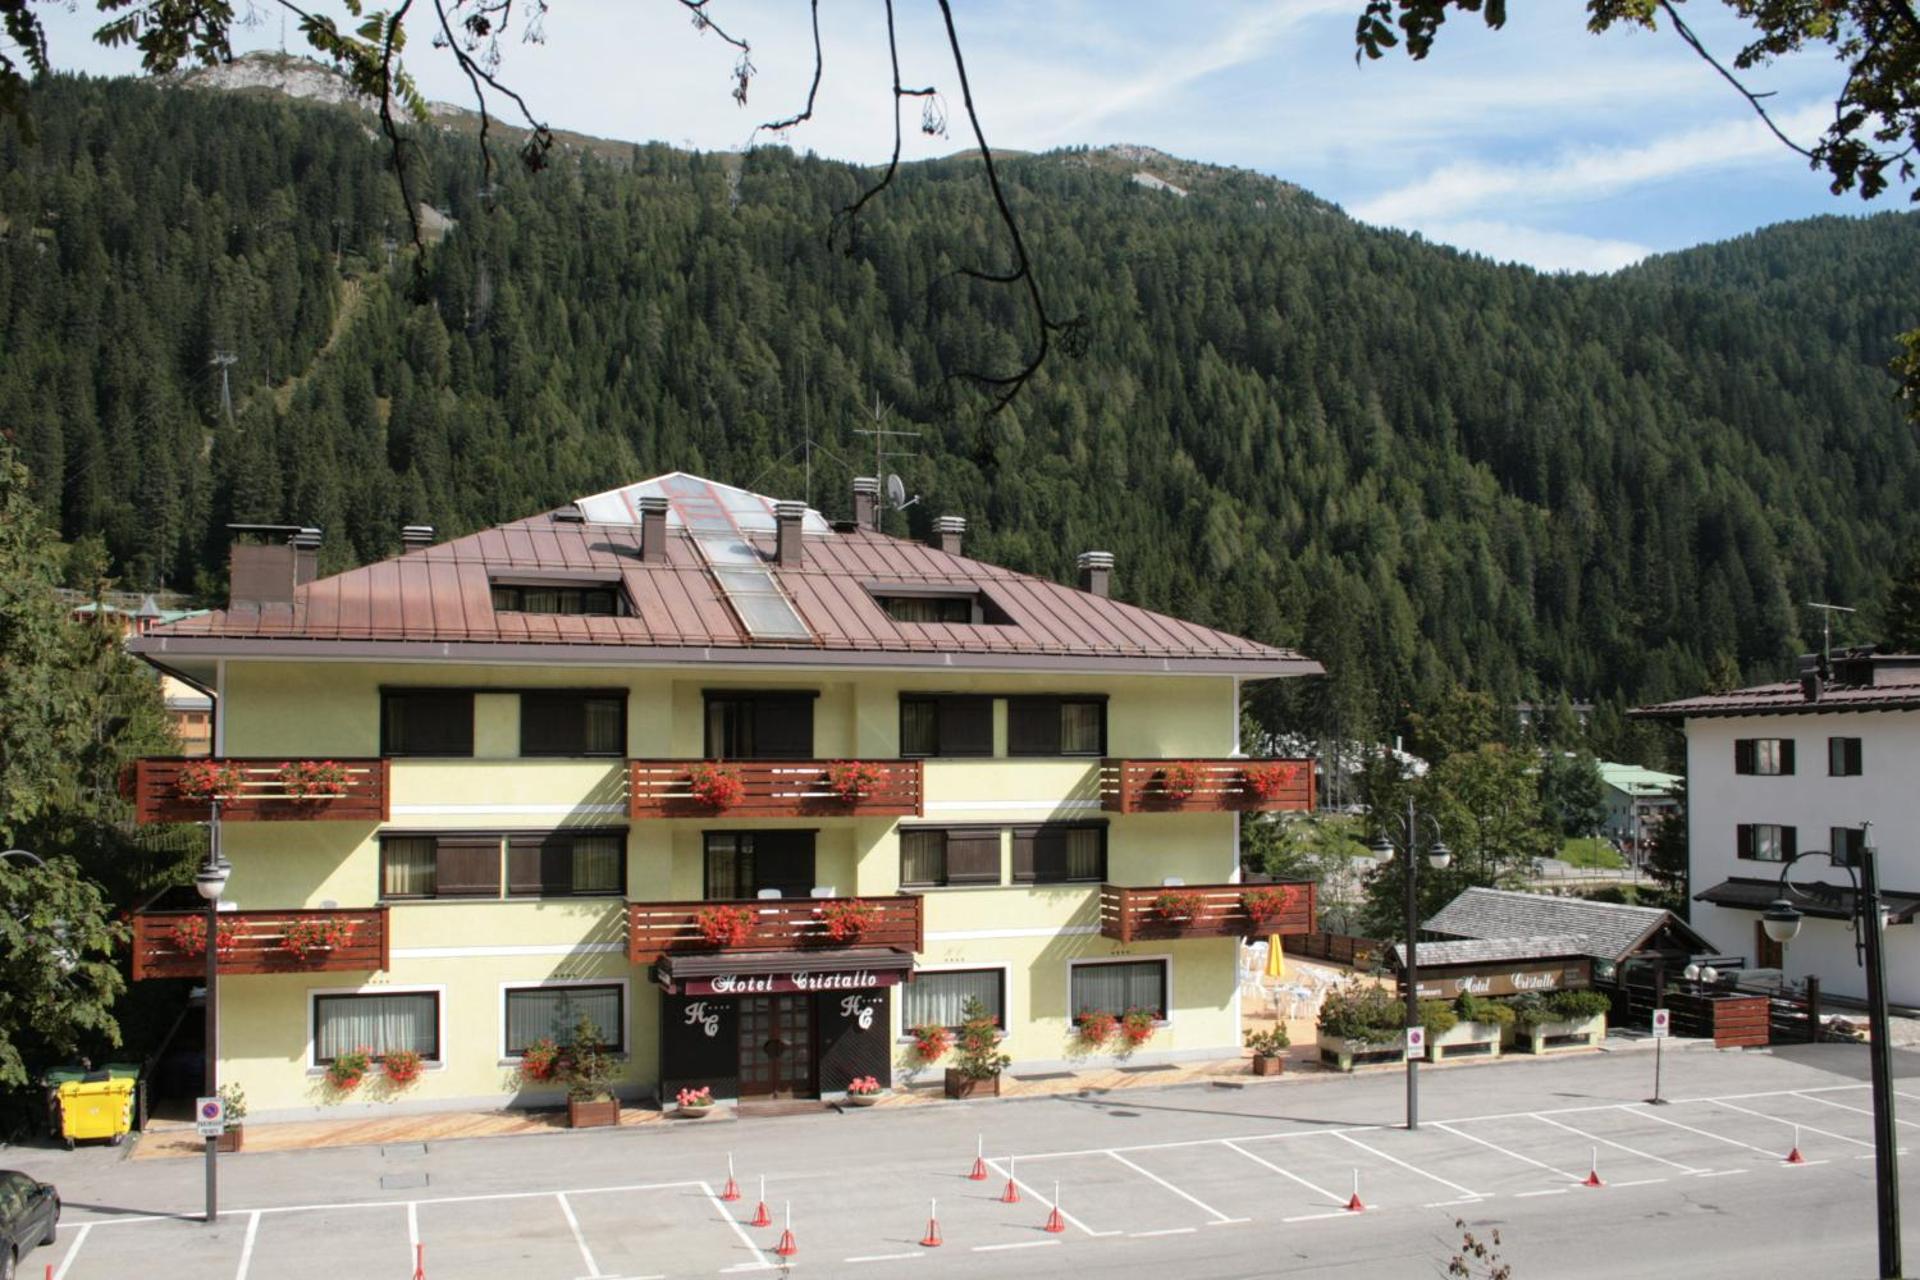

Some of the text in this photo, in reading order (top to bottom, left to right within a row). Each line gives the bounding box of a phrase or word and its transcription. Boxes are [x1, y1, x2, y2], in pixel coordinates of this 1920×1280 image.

[711, 970, 876, 992] Hotel Cristallo
[1456, 975, 1490, 993] Hotel
